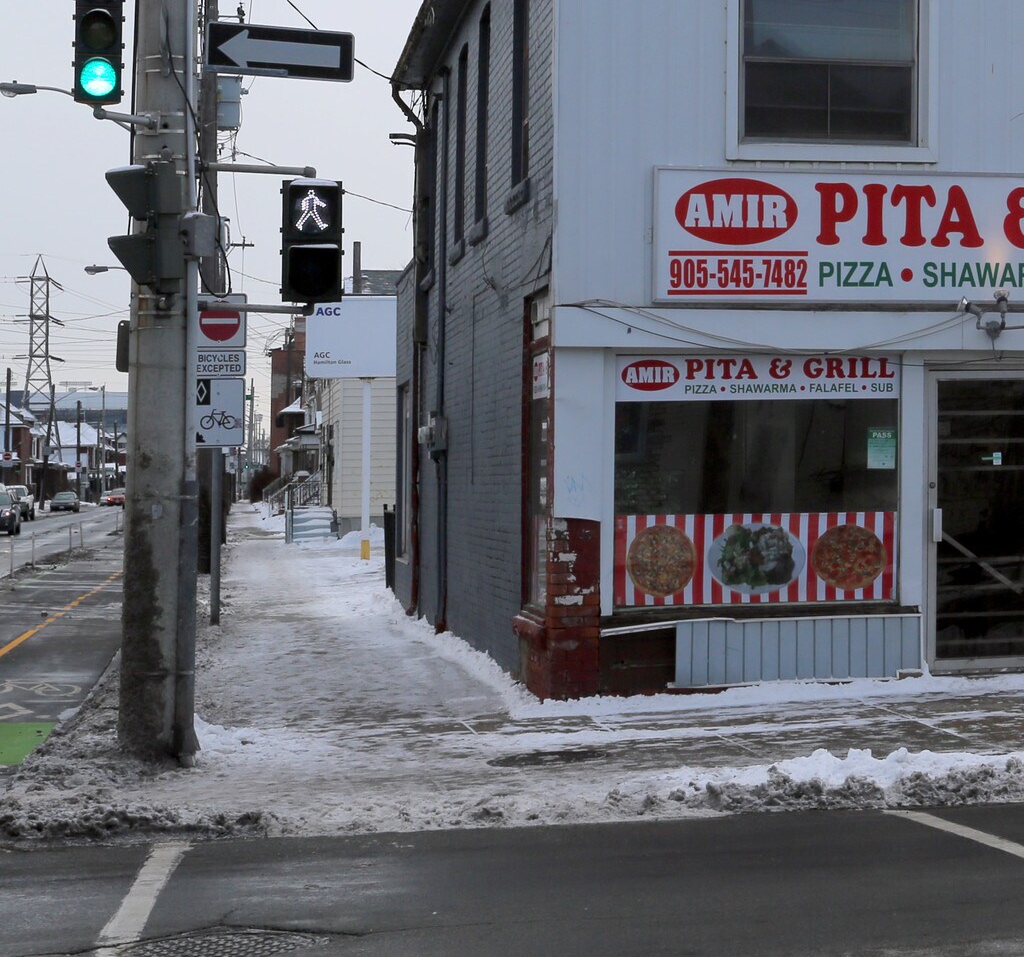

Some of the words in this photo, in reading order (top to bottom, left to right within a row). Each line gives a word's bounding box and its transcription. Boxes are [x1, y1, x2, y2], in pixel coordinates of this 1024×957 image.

[684, 193, 789, 229] AMIR
[814, 182, 985, 249] PITA
[669, 258, 808, 289] 905-545-7482
[818, 261, 894, 288] PIZZA
[315, 306, 341, 317] AGC
[198, 354, 240, 363] BICYCLES
[313, 351, 331, 359] AGC
[196, 364, 242, 373] EXCEPTED
[625, 366, 675, 383] AMIR
[684, 358, 758, 380] PITA
[769, 358, 793, 379] &
[803, 357, 895, 379] GRILL
[684, 384, 718, 394] PIZZA
[729, 383, 797, 393] SHAWARMA
[809, 382, 859, 393] FALAFEL
[870, 381, 894, 393] SUB
[872, 431, 892, 439] PASS
